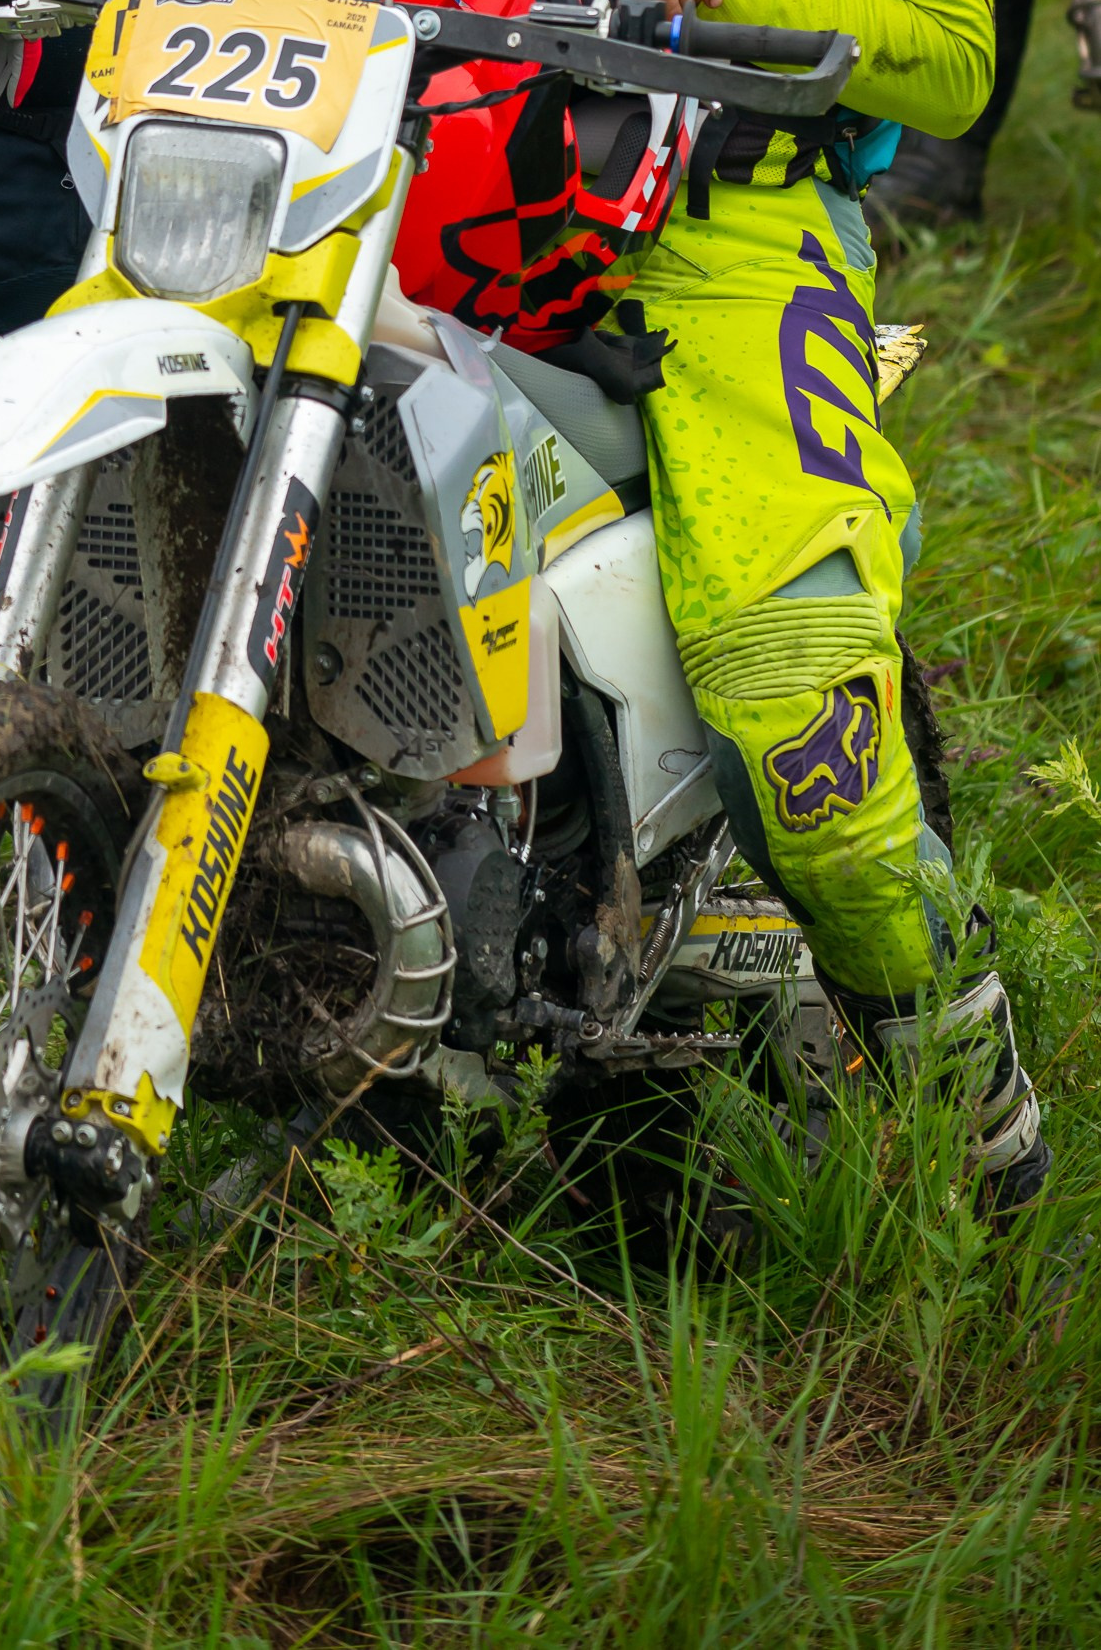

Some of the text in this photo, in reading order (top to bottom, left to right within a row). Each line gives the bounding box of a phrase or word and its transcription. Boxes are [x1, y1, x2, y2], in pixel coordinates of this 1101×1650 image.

[146, 26, 327, 110] 225
[181, 744, 258, 969] KOSHINE
[708, 930, 804, 975] KOSHINE
